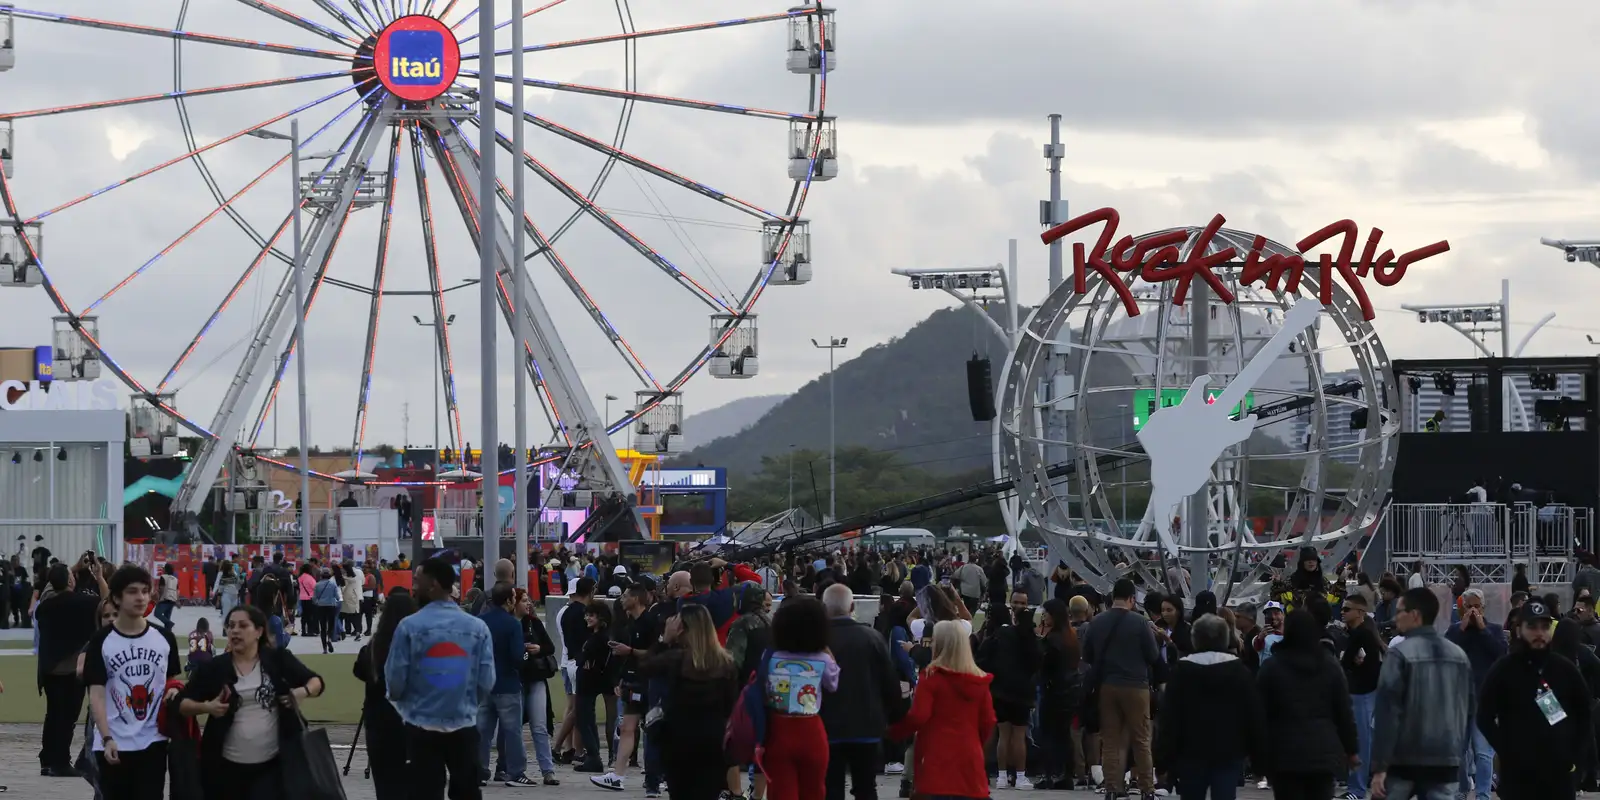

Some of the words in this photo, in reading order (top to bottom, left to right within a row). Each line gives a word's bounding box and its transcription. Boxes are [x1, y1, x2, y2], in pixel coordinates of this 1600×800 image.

[392, 56, 441, 78] Itaú
[1040, 207, 1237, 318] Rock
[1239, 234, 1306, 294] in
[1295, 218, 1451, 321] Rio
[39, 363, 52, 376] Ita
[125, 664, 150, 677] CLUB
